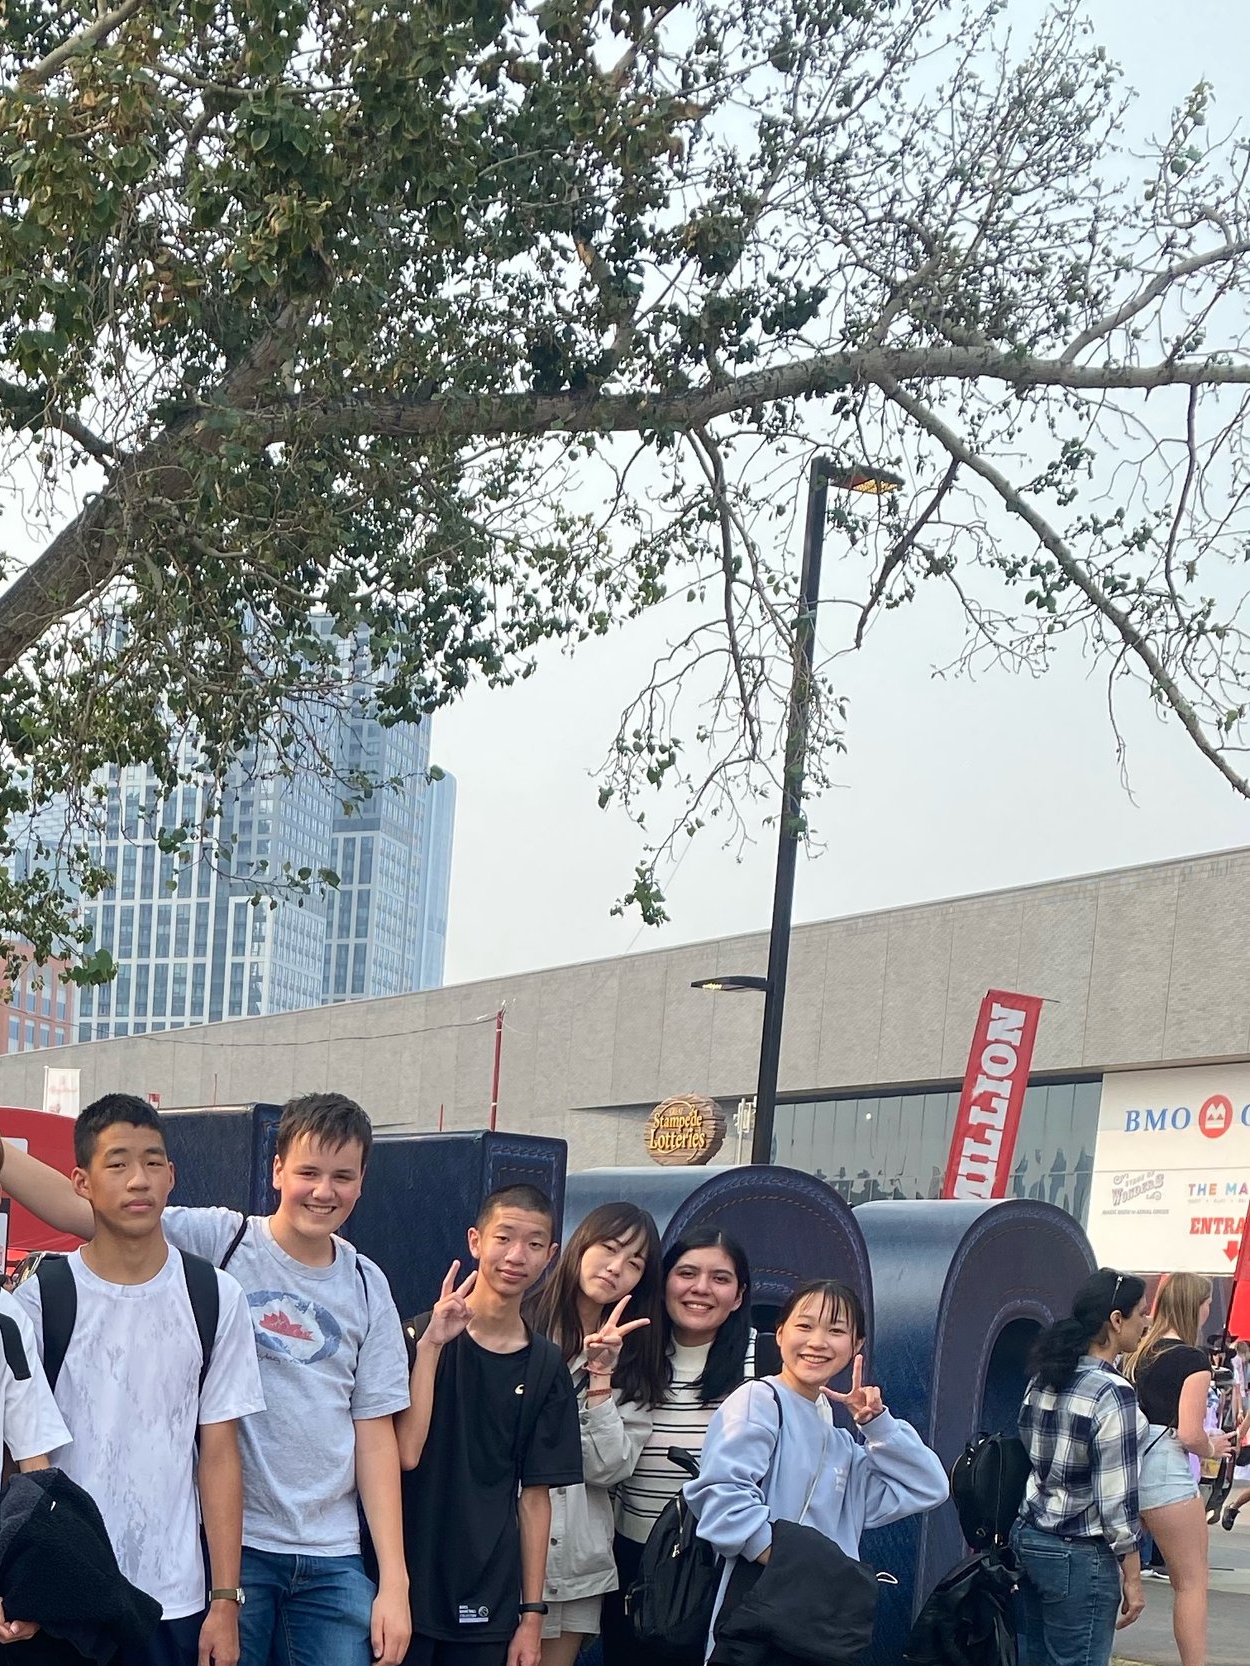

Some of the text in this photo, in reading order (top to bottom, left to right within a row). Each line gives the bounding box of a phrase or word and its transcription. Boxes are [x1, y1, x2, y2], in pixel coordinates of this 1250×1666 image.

[654, 1109, 702, 1131] Stampede
[1124, 1107, 1191, 1132] BMO
[650, 1128, 705, 1149] Lotteries
[1188, 1183, 1217, 1196] THE
